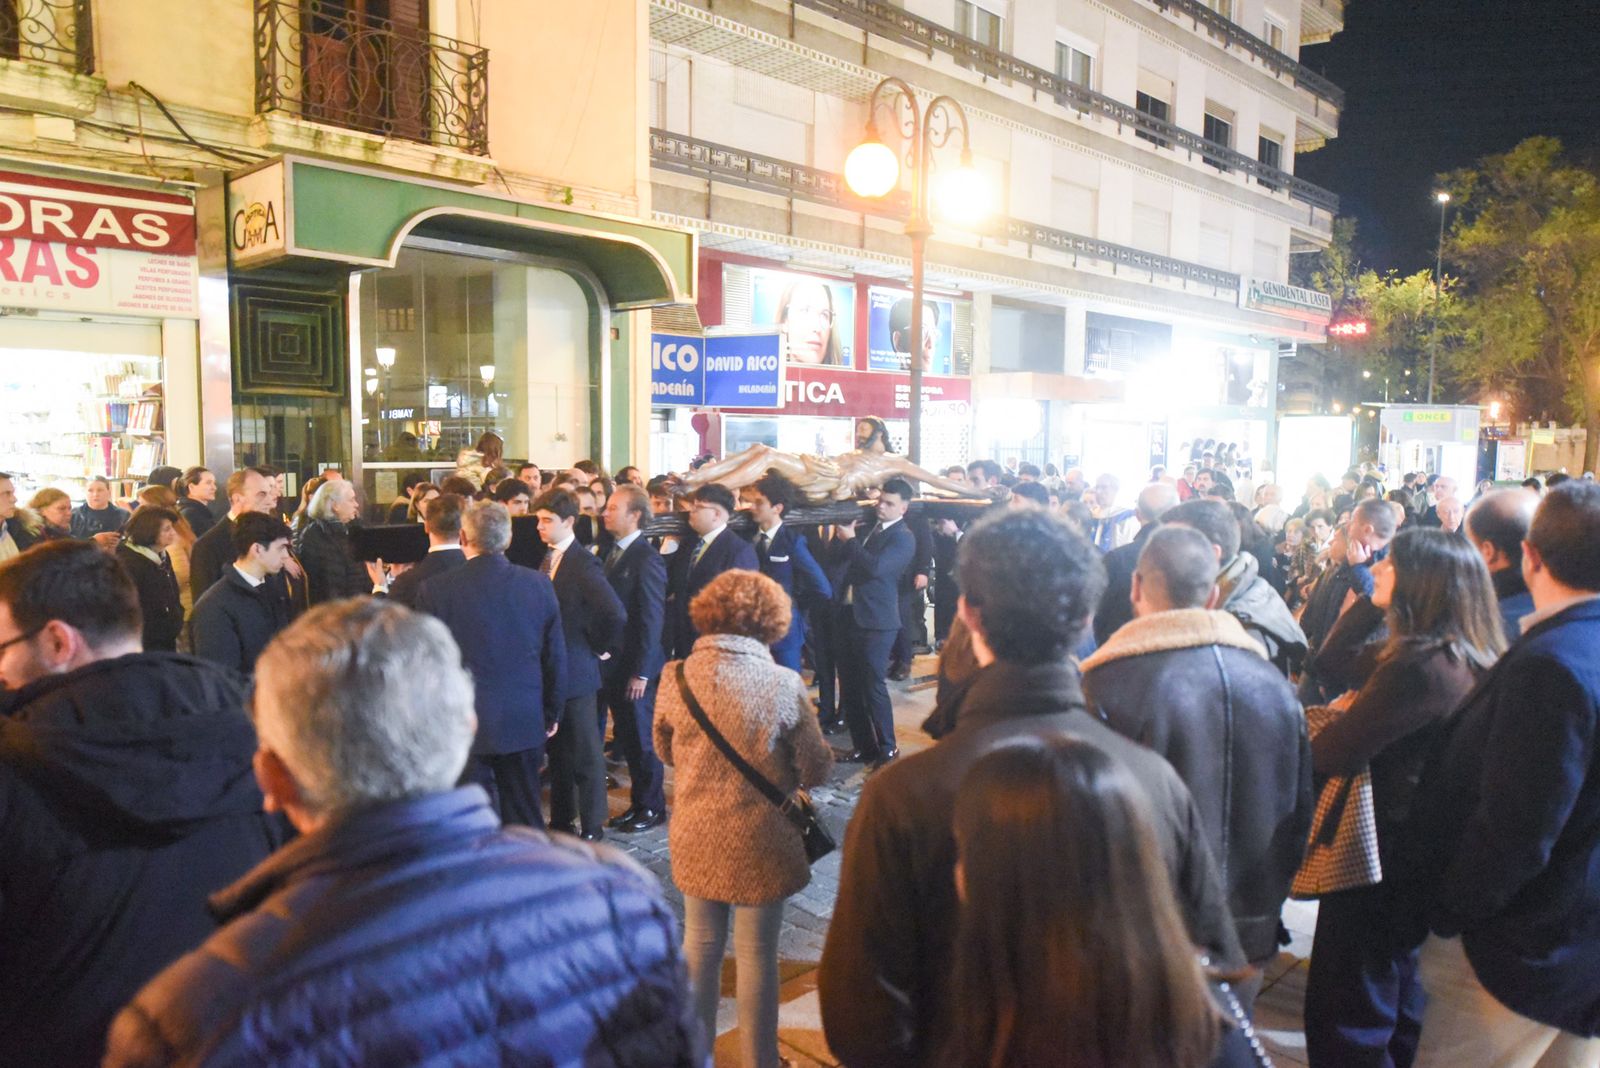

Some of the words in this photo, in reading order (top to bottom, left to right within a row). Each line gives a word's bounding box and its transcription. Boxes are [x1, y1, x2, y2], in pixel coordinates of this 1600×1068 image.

[1262, 281, 1308, 302] GENIDENTAL
[1309, 291, 1330, 308] LASER
[705, 356, 744, 372] DAVID
[746, 355, 778, 371] RICO
[1416, 411, 1447, 423] ONCE
